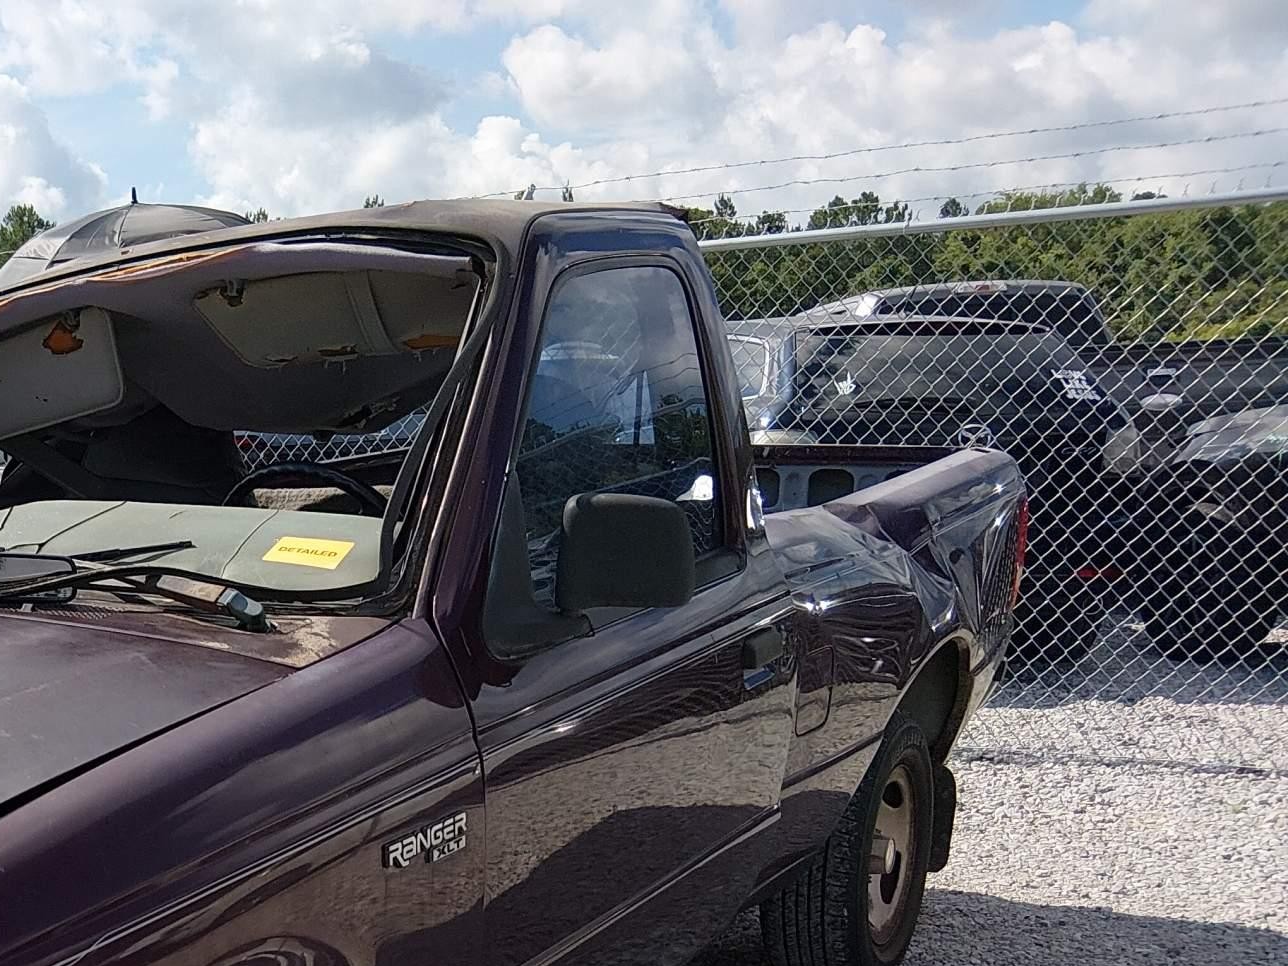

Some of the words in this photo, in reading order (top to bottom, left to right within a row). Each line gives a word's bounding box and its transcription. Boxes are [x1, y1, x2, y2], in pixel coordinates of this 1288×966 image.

[277, 546, 339, 558] DETAILED
[387, 811, 468, 868] RANGER
[435, 836, 465, 860] XLT
